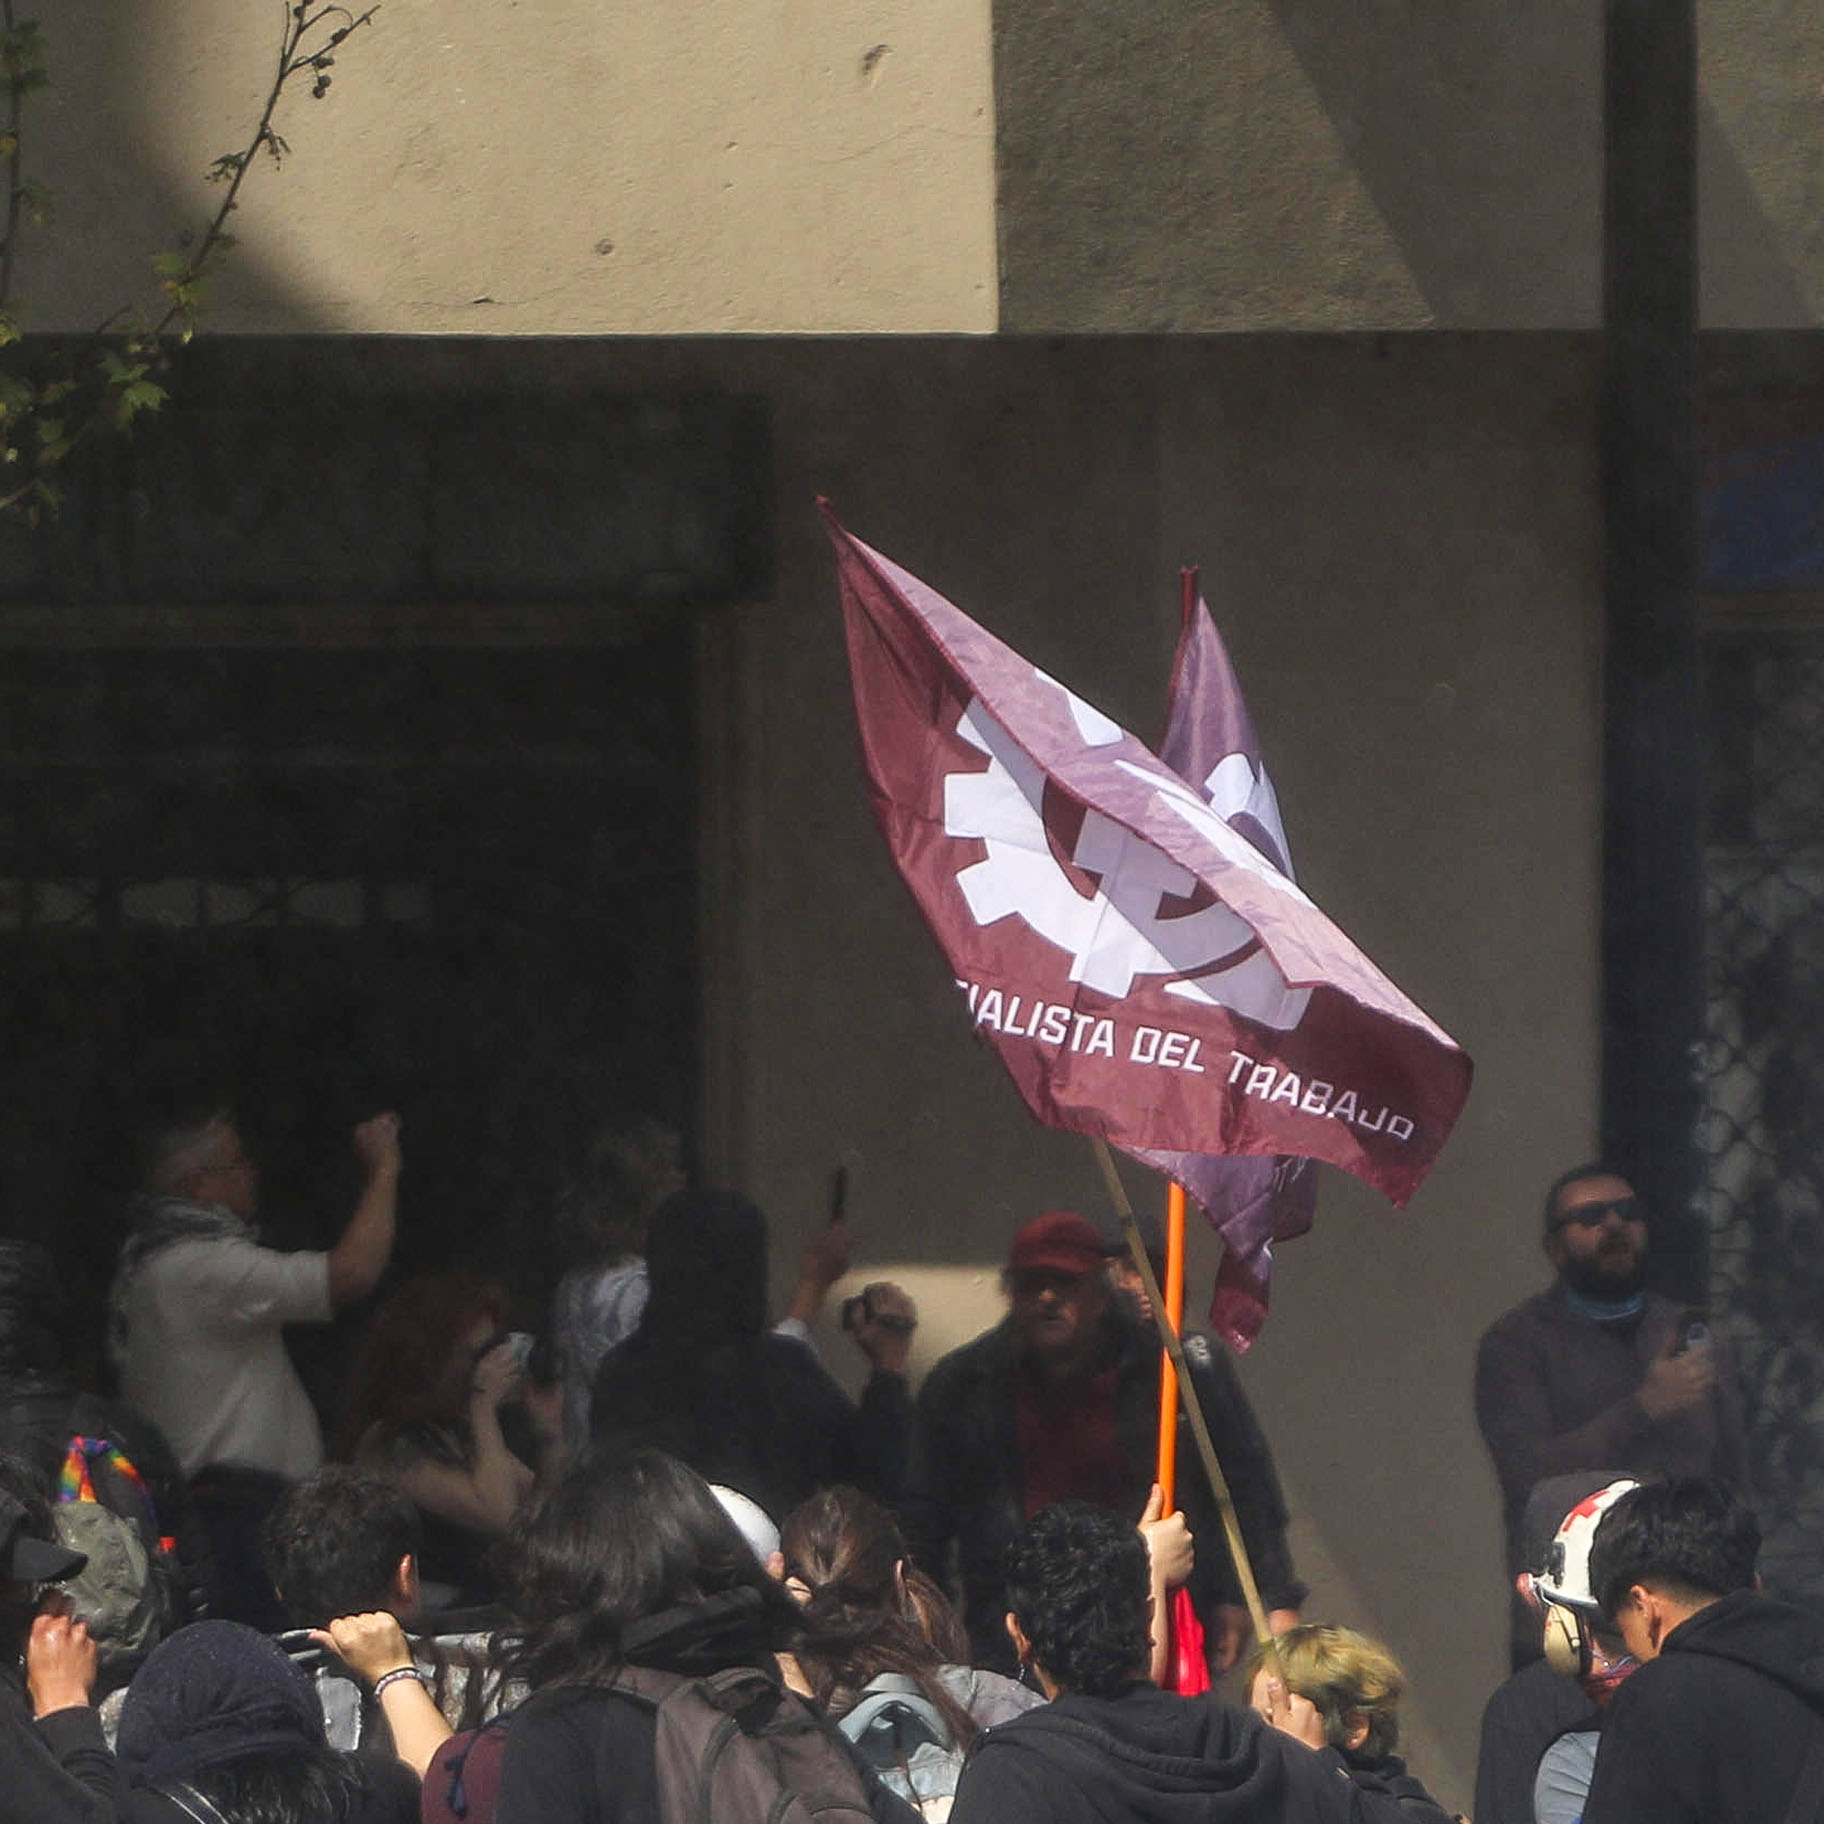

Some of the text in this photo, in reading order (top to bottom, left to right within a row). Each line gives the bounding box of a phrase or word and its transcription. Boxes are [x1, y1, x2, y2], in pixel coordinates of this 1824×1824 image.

[956, 980, 1416, 1141] IALISTA DEL TRABAJO
